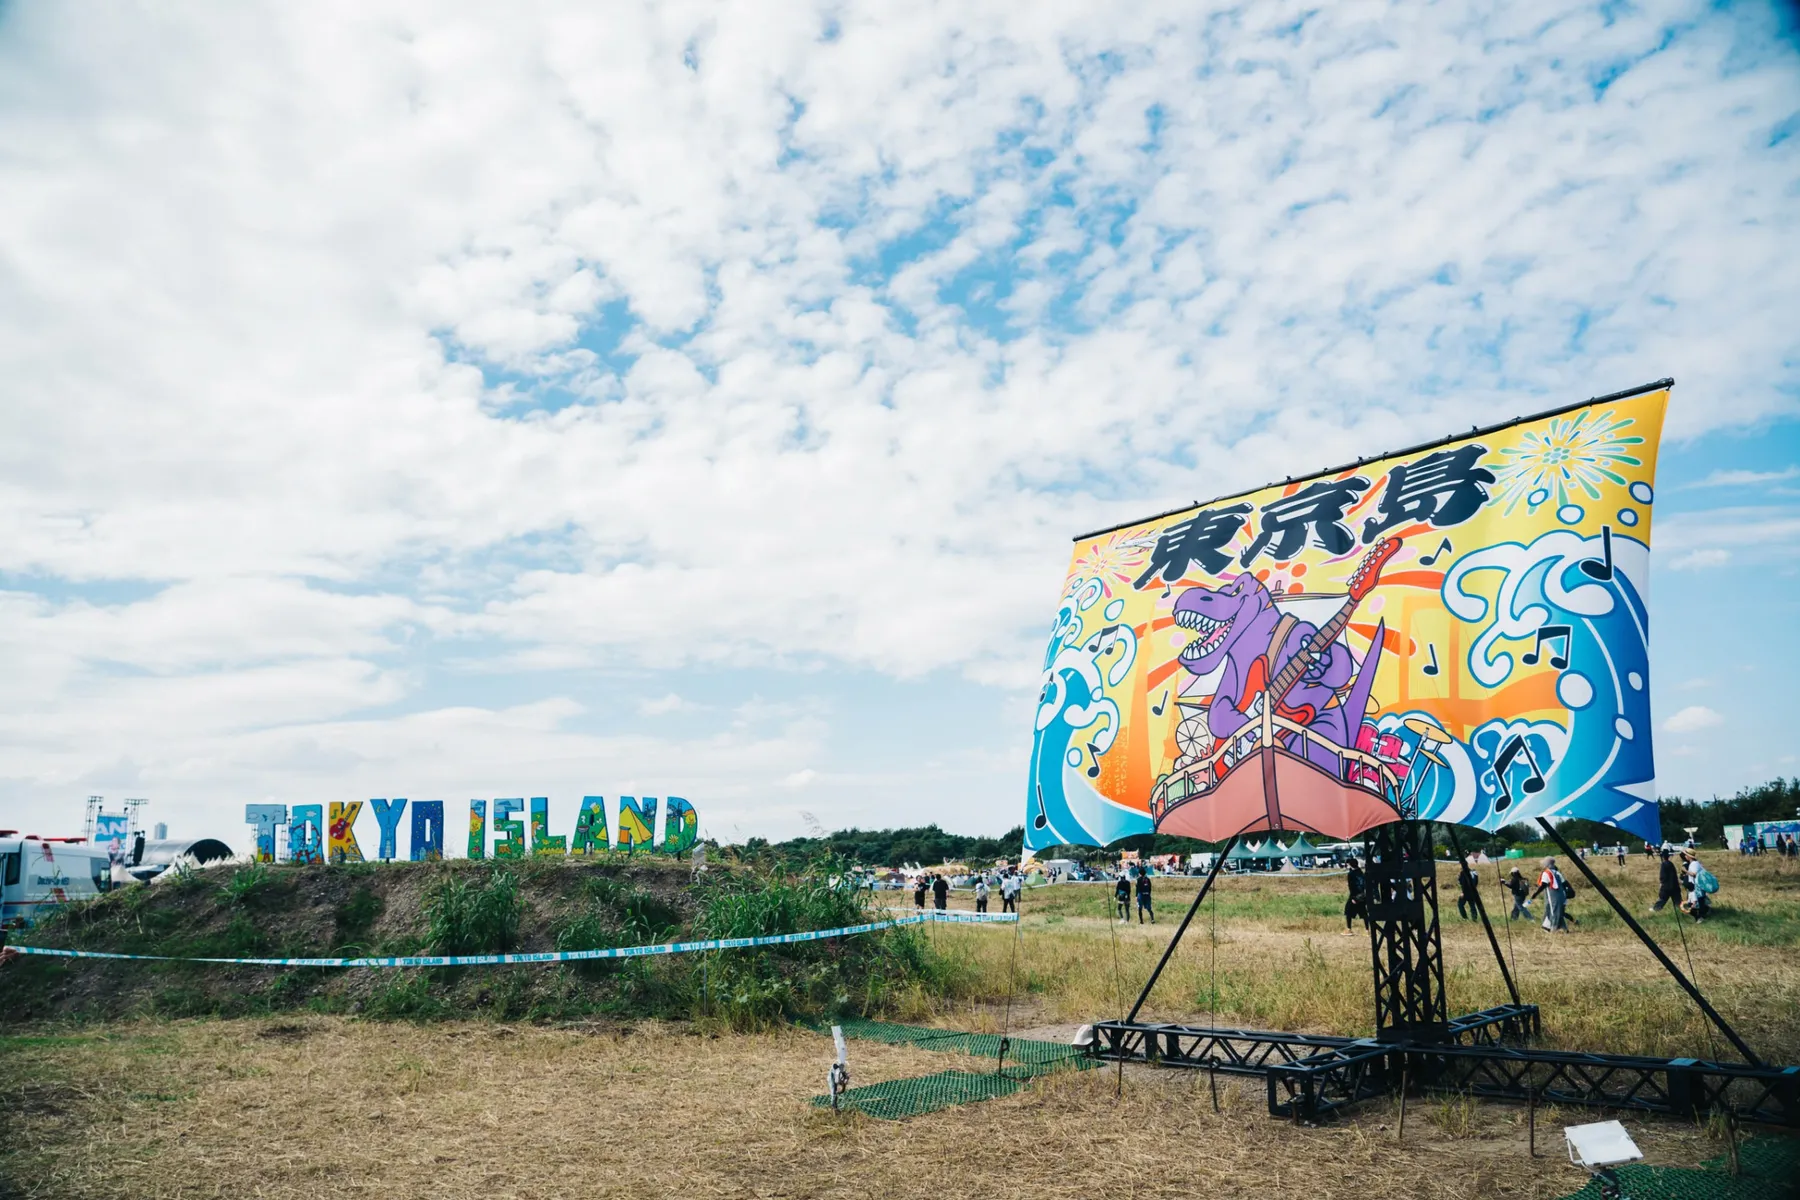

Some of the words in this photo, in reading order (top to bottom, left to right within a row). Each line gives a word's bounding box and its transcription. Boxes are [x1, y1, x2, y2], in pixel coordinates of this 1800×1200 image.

[1132, 444, 1497, 590] 東京島
[245, 798, 444, 864] TOKYO
[467, 796, 698, 858] ISLAND
